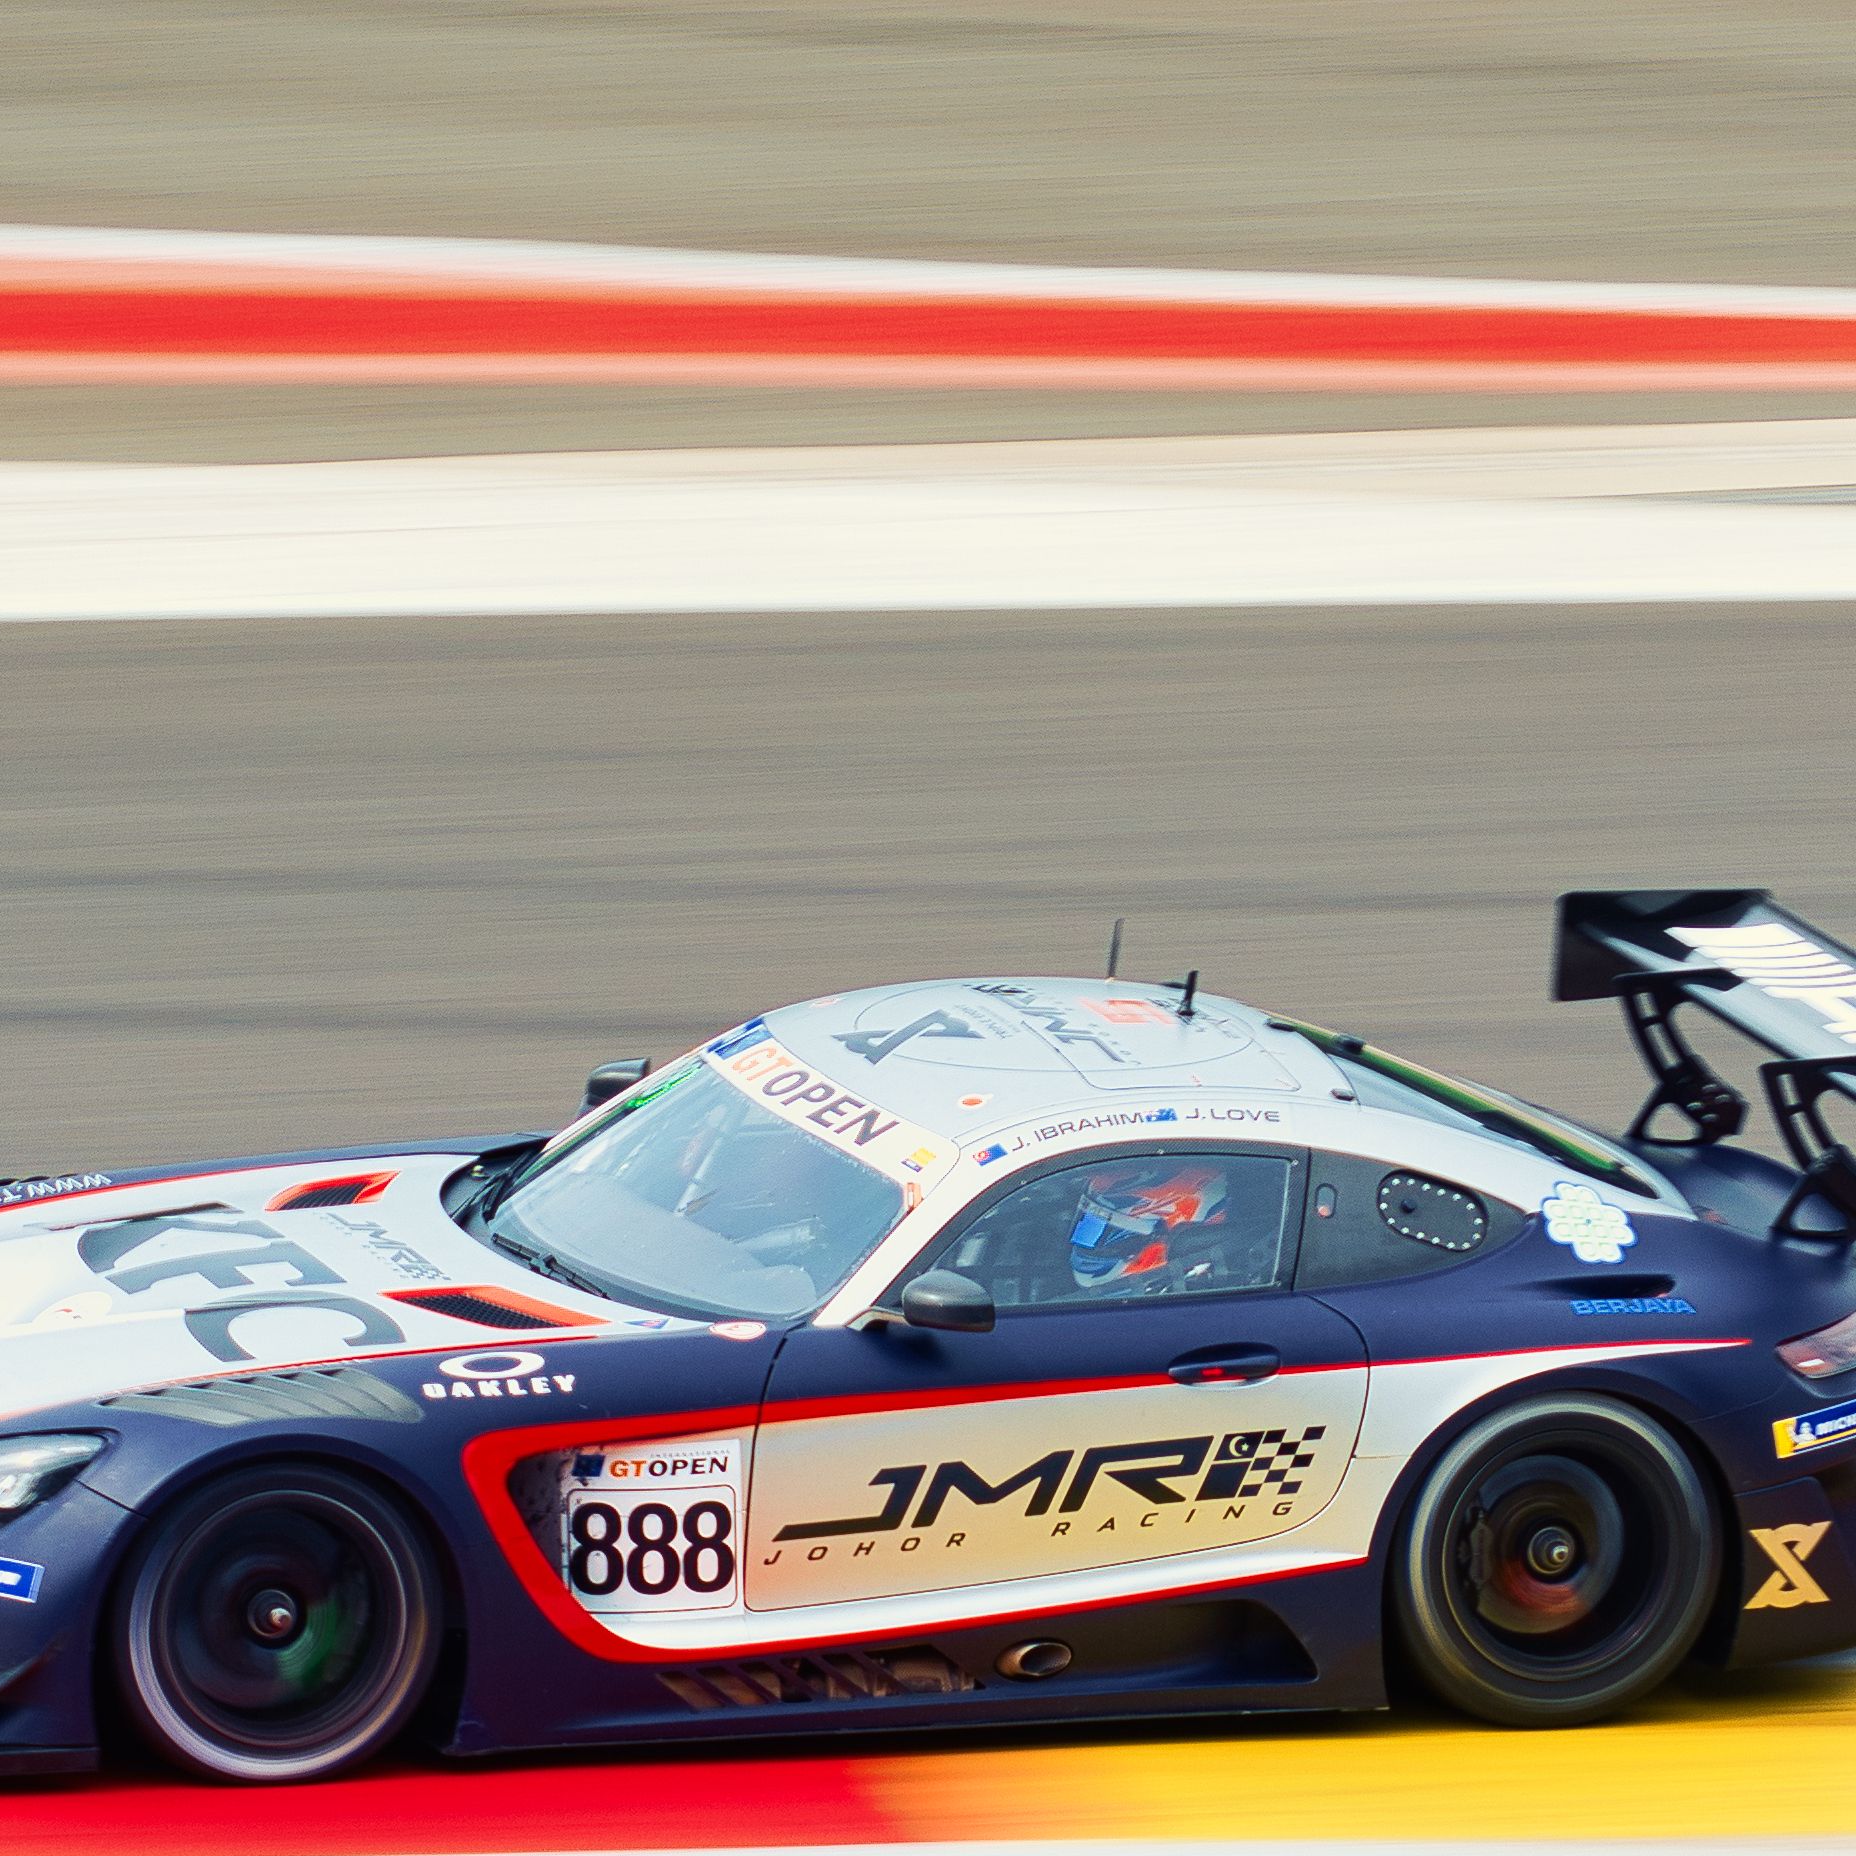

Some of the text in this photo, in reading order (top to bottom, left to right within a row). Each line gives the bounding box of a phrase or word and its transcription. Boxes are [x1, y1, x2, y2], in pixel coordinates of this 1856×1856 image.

[1034, 1112, 1146, 1142] IBRAHIM
[1210, 1108, 1280, 1122] LOVE
[1570, 1299, 1696, 1315] BERJAYA
[422, 1374, 575, 1399] OAKLEY
[772, 1435, 1214, 1542] JMR
[571, 1500, 734, 1595] 888
[763, 1501, 1294, 1567] JOHOR RACING
